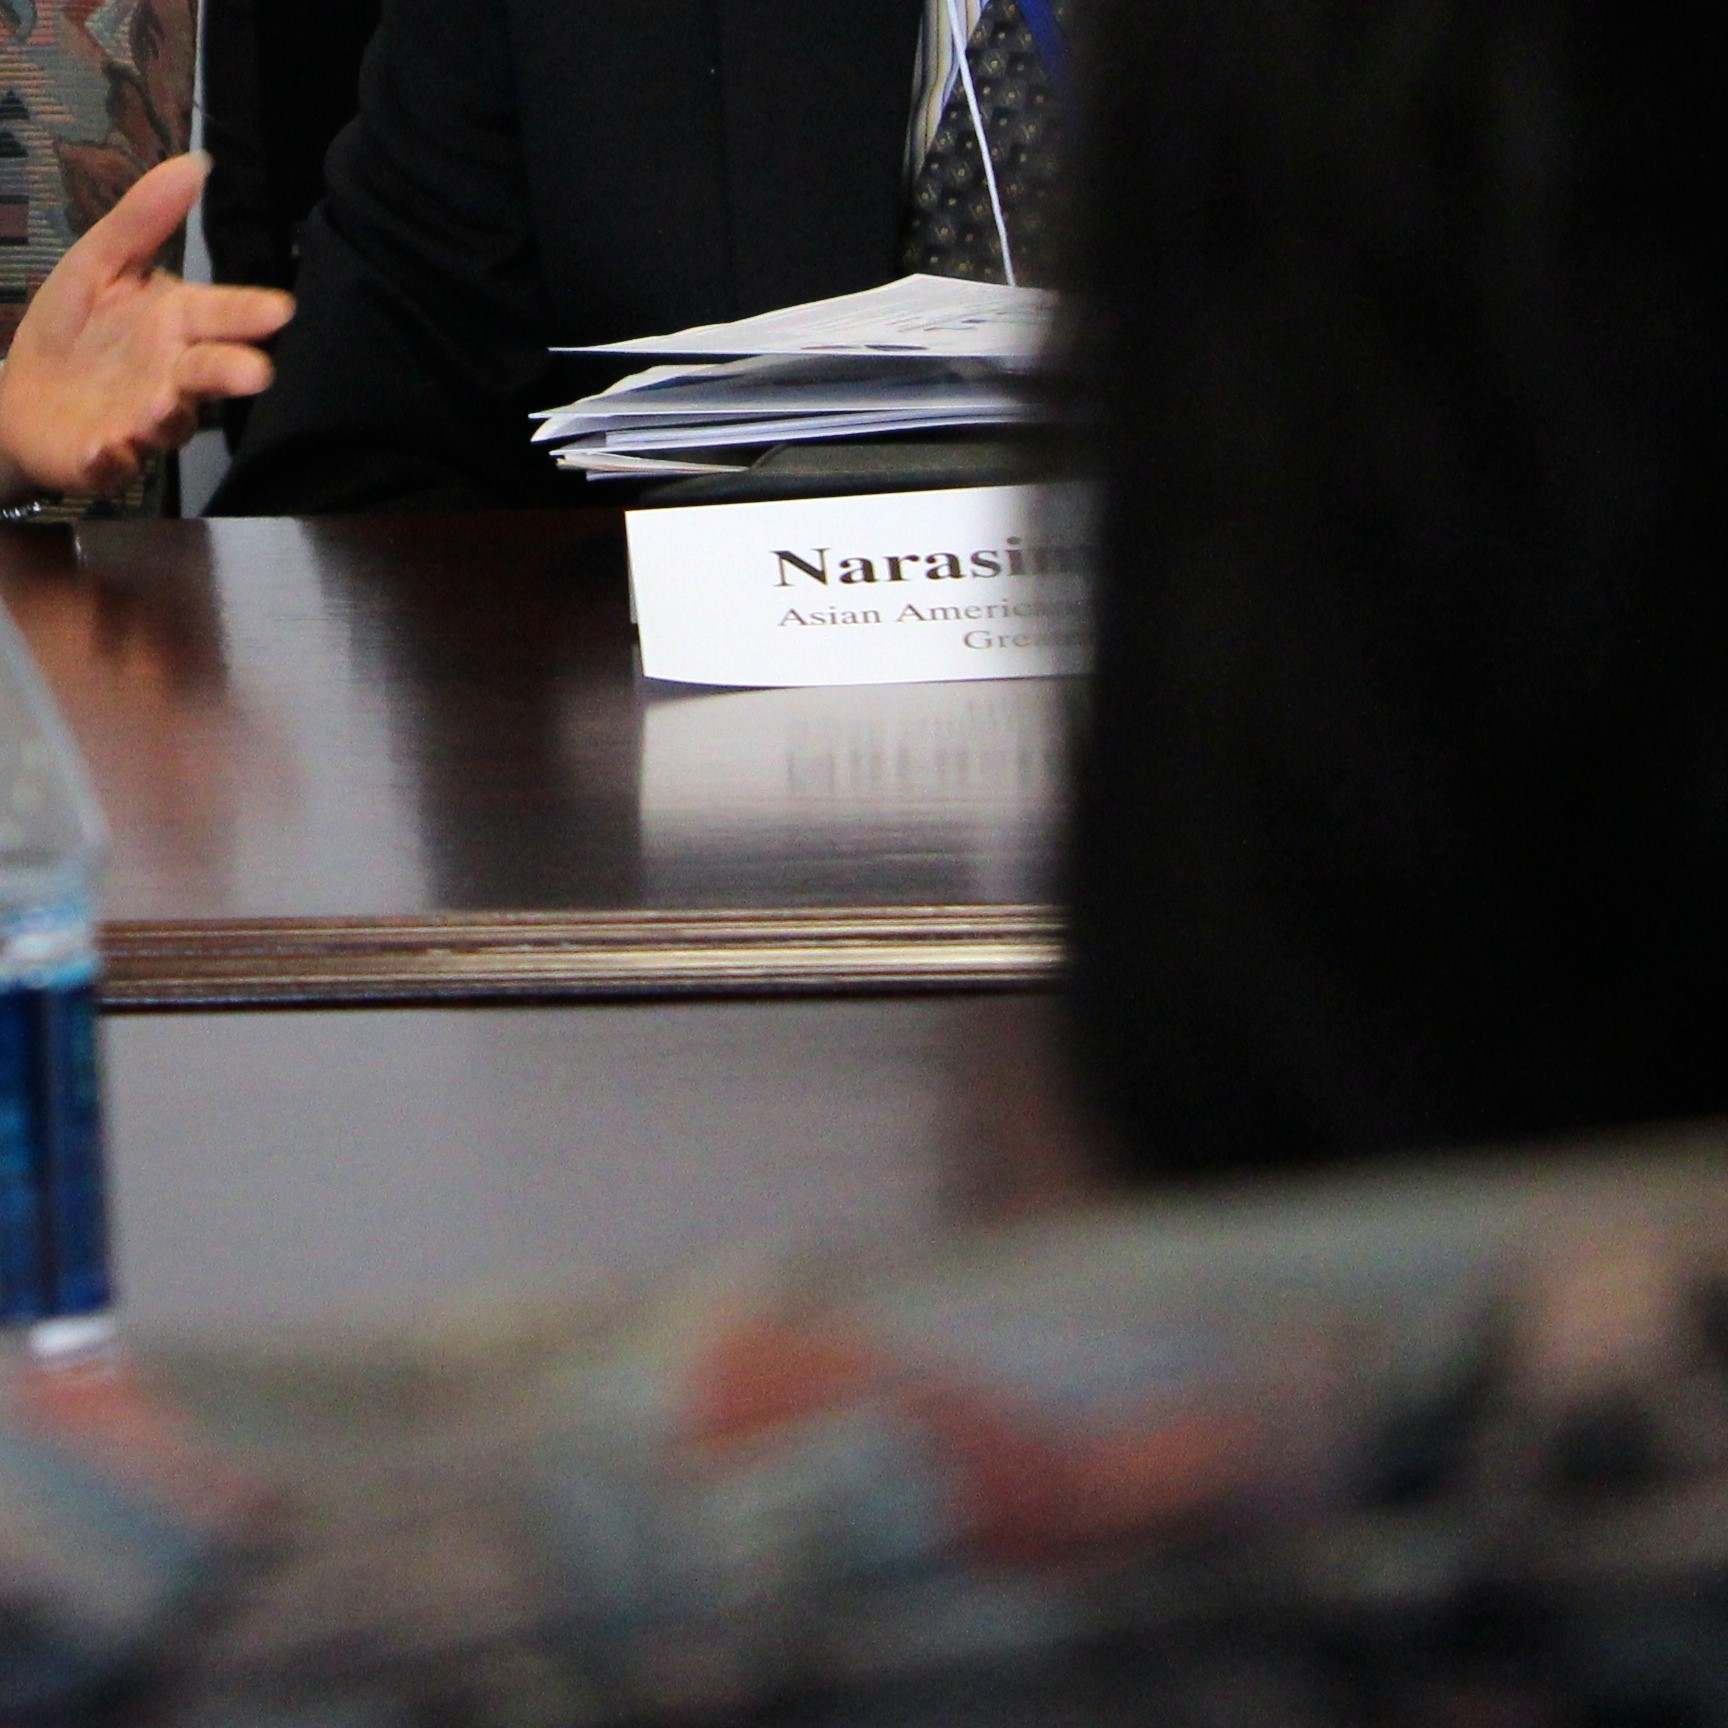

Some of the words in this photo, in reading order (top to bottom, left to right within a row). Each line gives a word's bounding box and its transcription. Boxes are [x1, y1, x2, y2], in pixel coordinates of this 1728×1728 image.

[769, 536, 1046, 587] Narasi
[778, 605, 882, 627] Asian
[896, 598, 1044, 623] Americ
